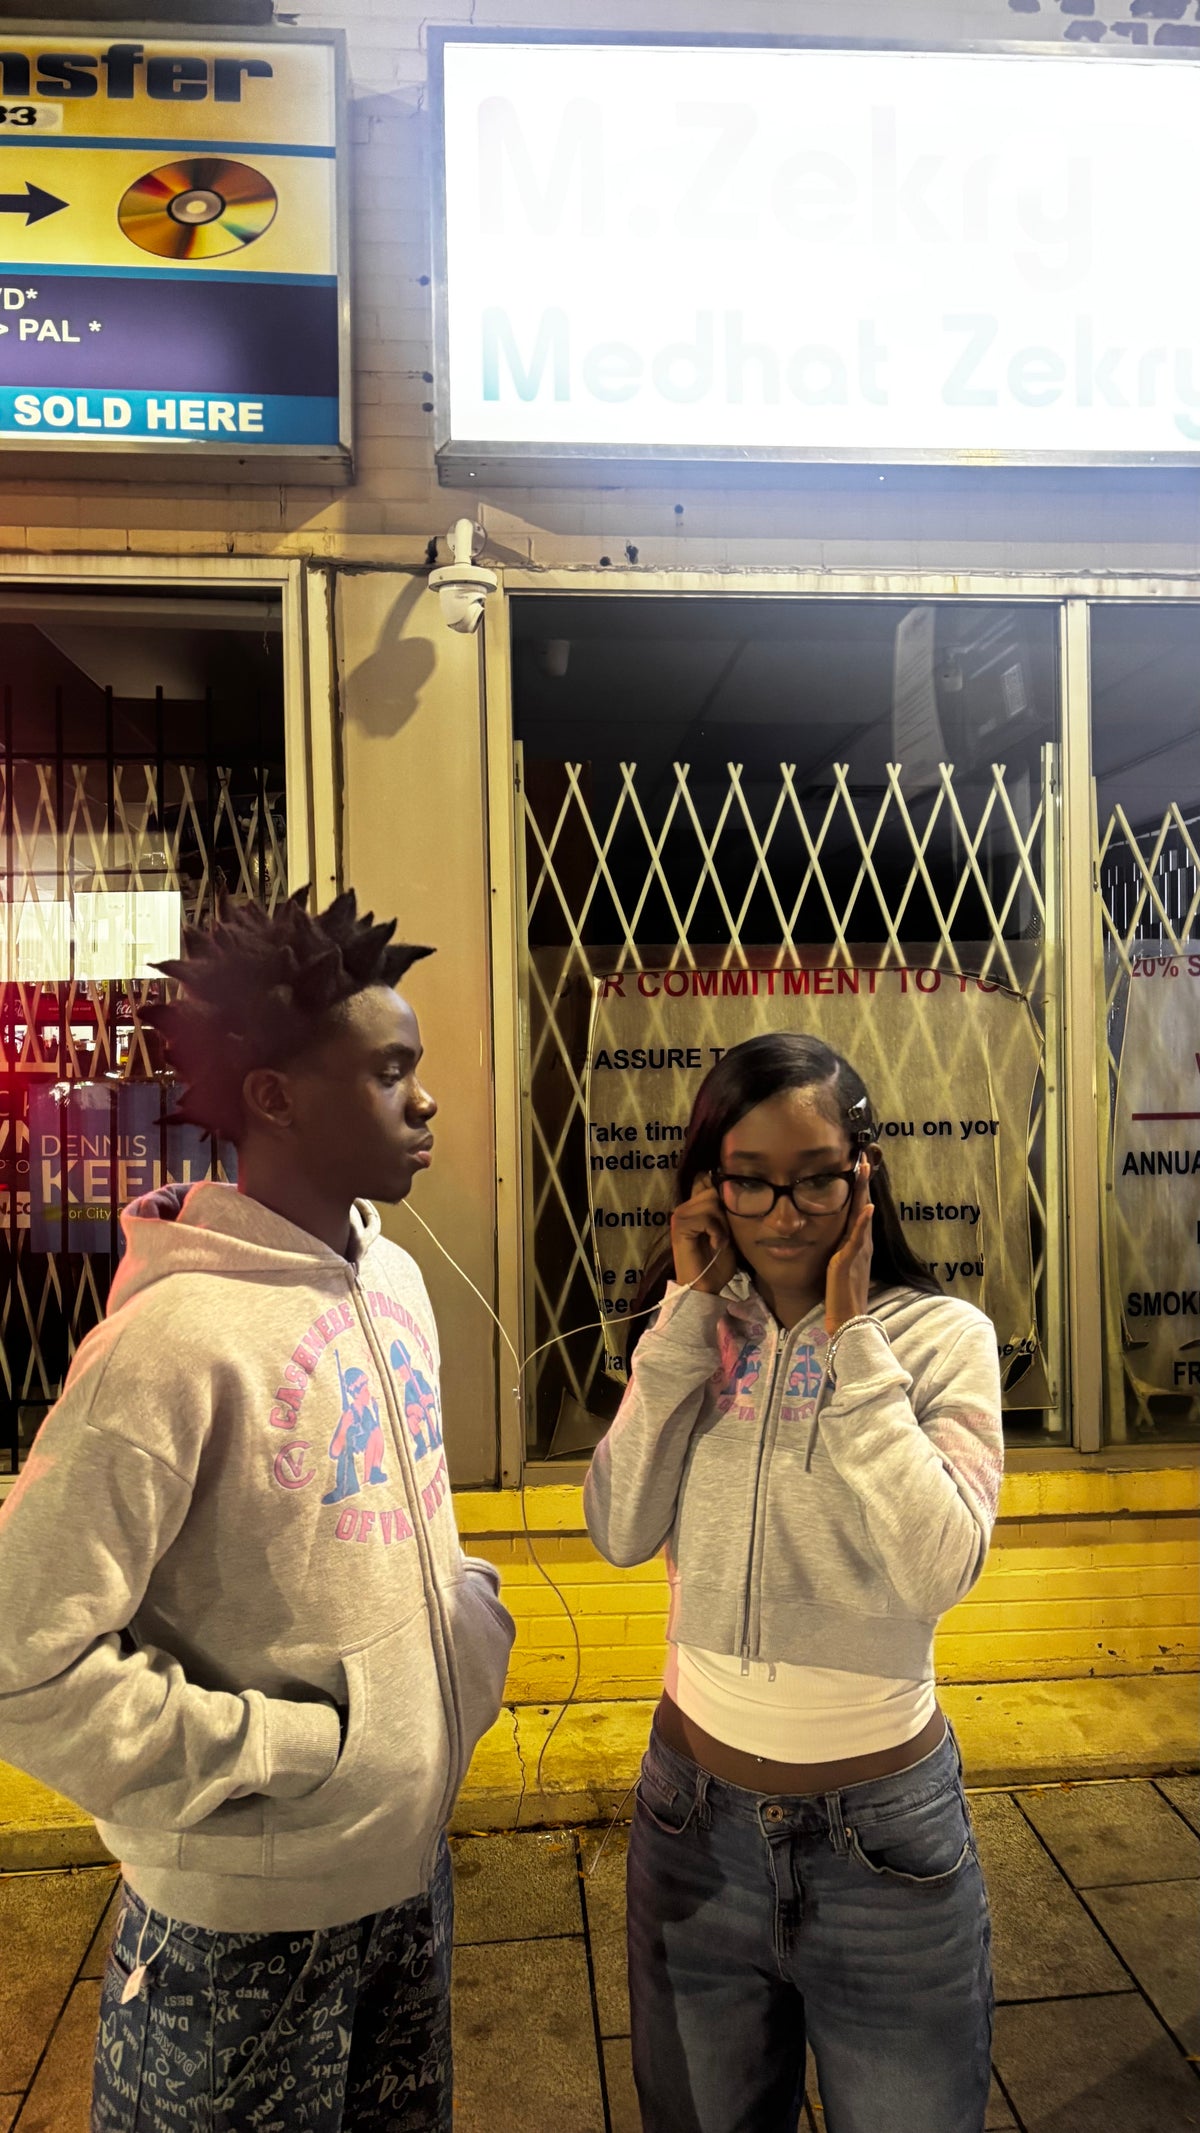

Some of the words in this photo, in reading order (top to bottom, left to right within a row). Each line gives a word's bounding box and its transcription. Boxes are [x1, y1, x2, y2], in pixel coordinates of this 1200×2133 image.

[19, 318, 81, 342] PAL
[480, 305, 891, 405] Medhat
[14, 395, 131, 428] SOLD
[147, 399, 264, 432] HERE
[637, 968, 884, 997] COMMITMENT
[894, 967, 942, 994] TO
[594, 1048, 702, 1070] ASSURE
[922, 1121, 952, 1136] on
[41, 1134, 148, 1157] DENNIS
[900, 1201, 981, 1225] history
